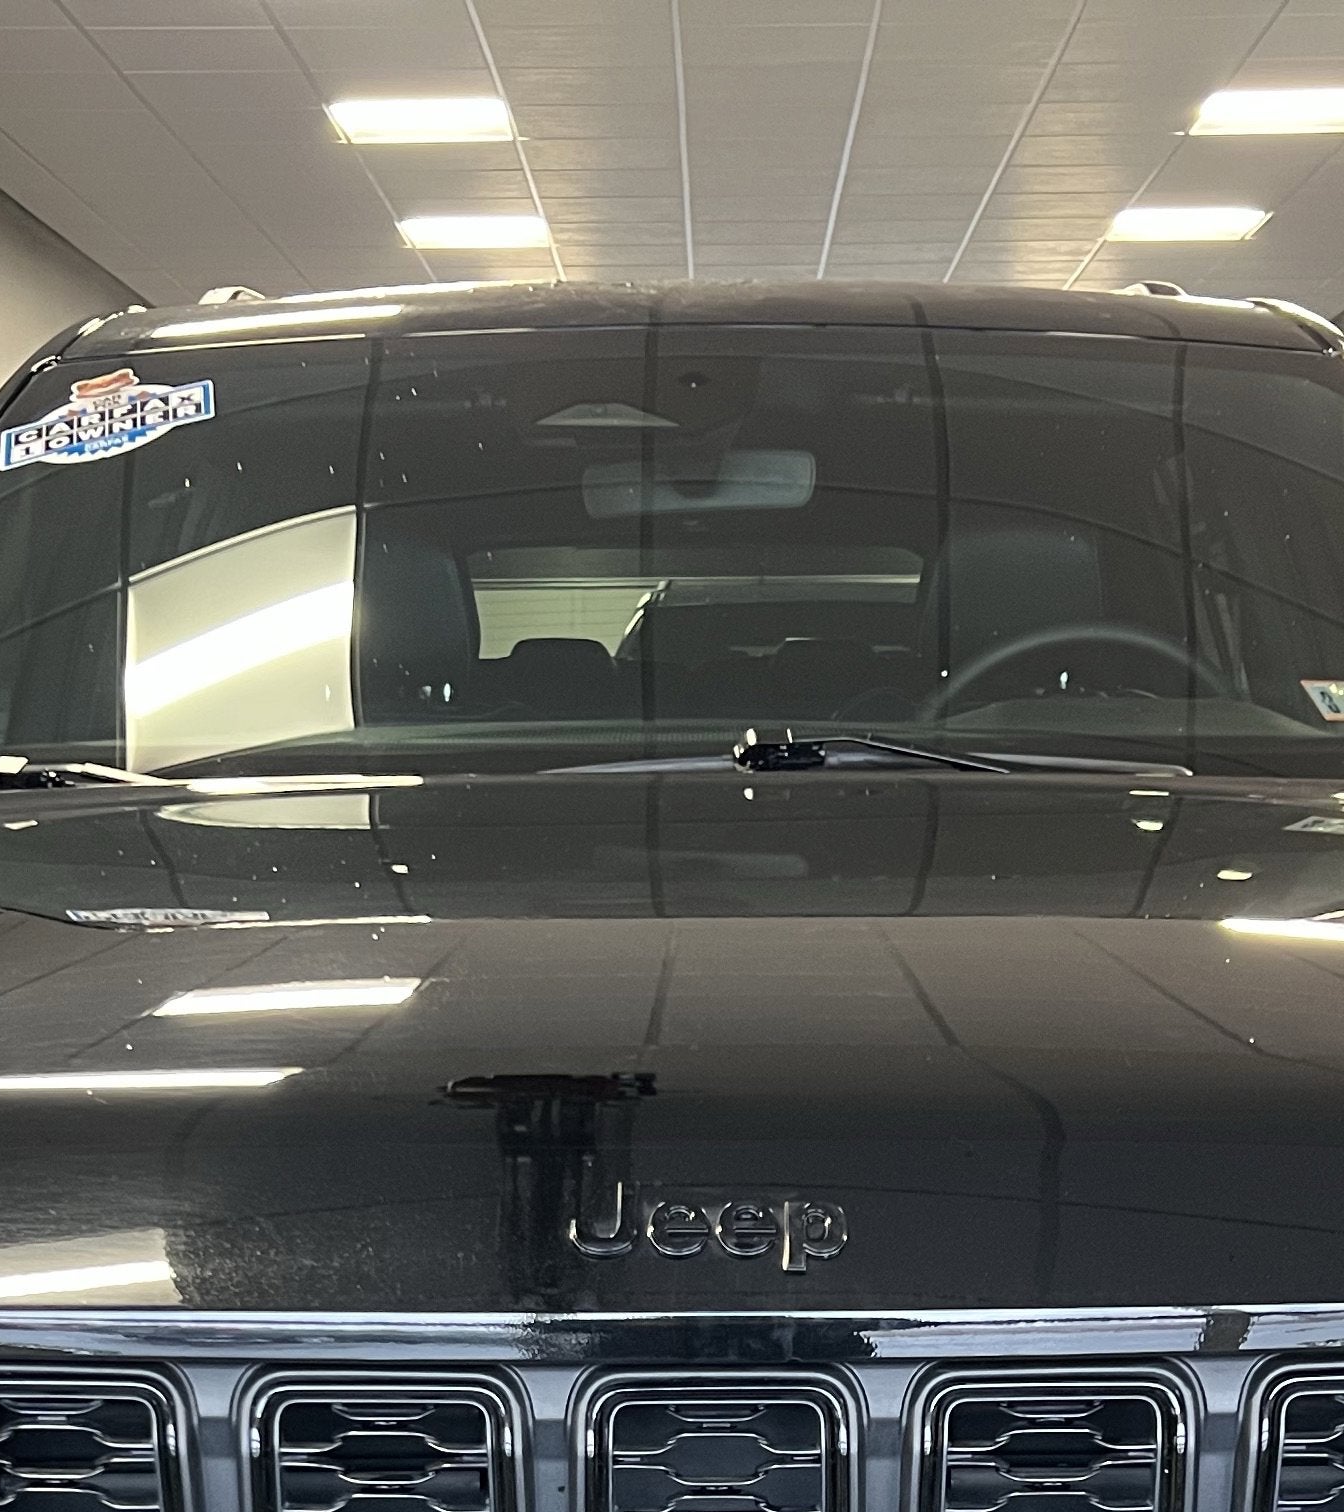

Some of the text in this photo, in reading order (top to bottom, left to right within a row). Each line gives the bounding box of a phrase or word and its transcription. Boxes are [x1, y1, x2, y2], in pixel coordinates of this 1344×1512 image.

[17, 392, 196, 444] CARFAX
[19, 444, 34, 458] 1
[47, 404, 196, 449] OWNER
[568, 1181, 848, 1272] Jeep
